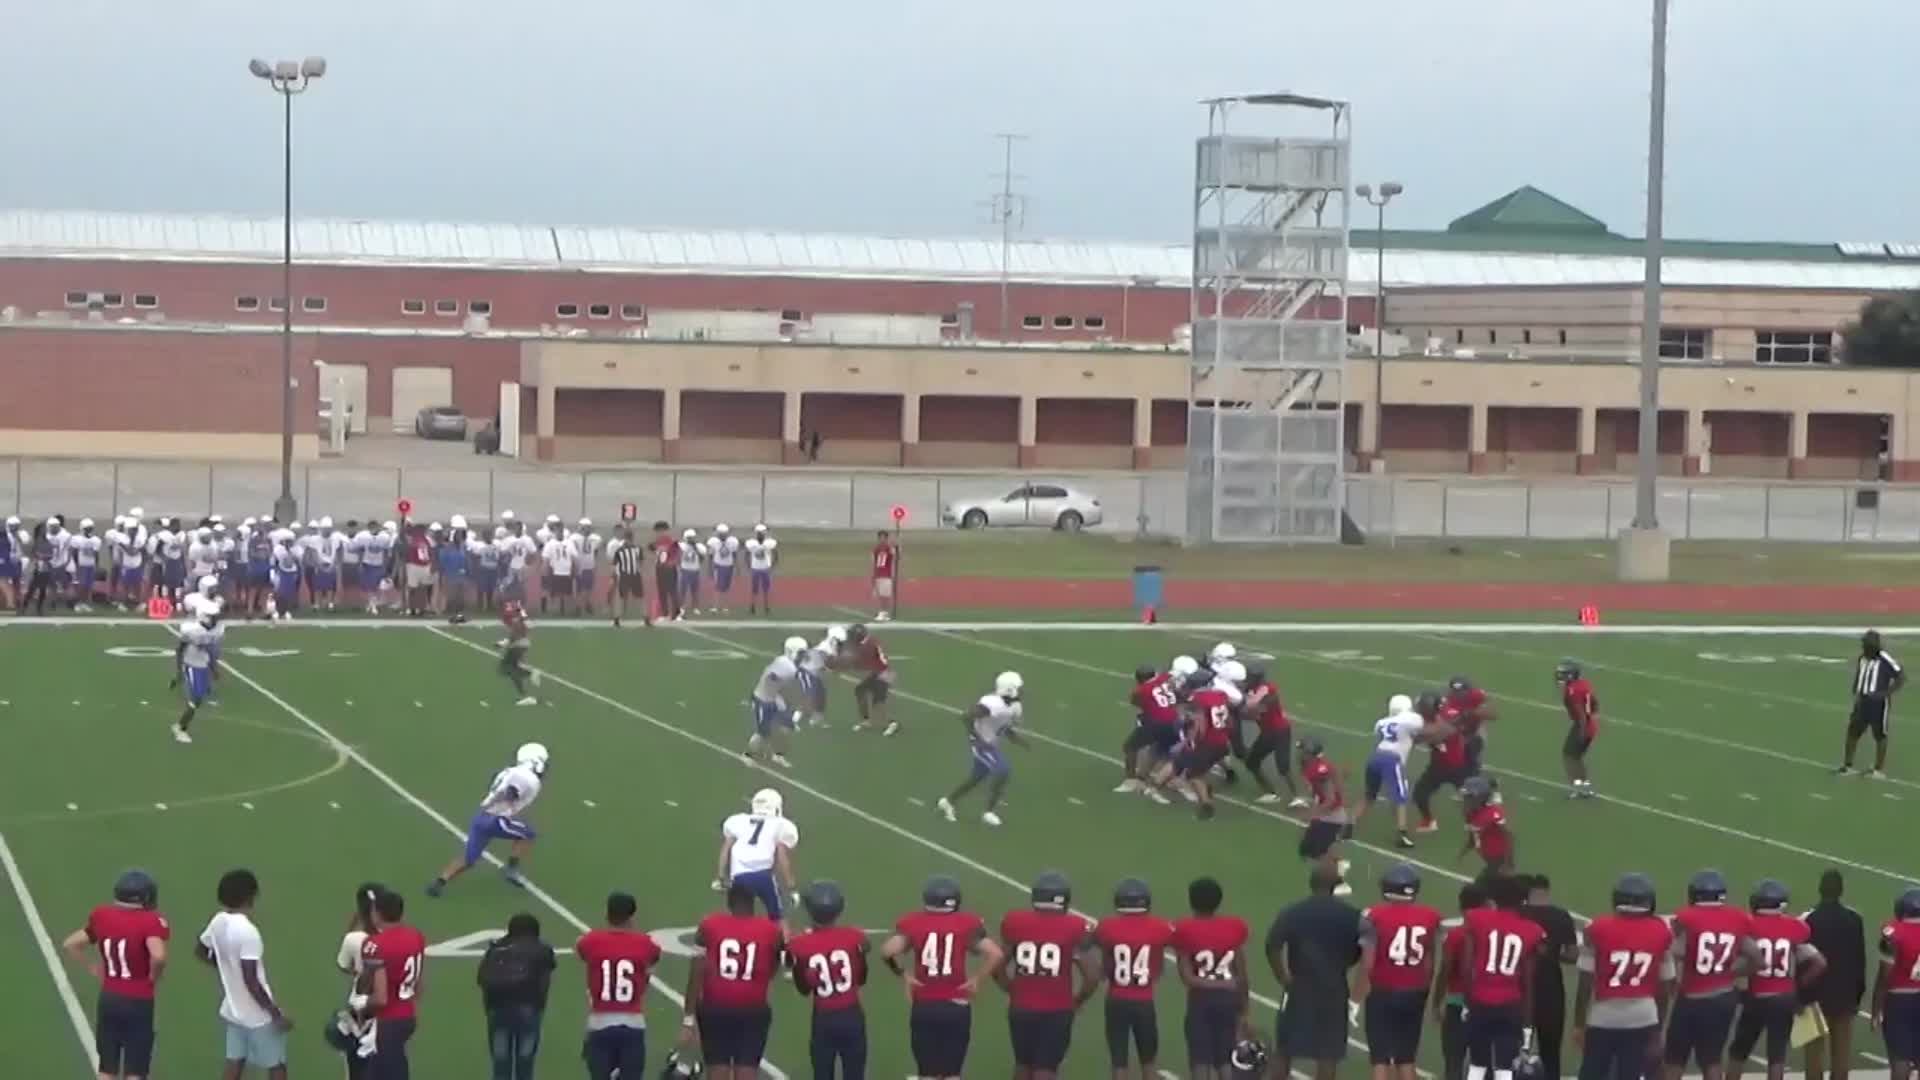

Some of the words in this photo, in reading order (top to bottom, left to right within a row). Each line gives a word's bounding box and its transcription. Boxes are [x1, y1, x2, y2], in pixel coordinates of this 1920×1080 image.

[747, 818, 765, 845] 7
[103, 937, 132, 979] 11
[719, 938, 755, 981] 61
[921, 932, 954, 977] 41
[1016, 941, 1061, 977] 99
[1113, 944, 1151, 986] 84
[1388, 925, 1427, 966] 45
[1485, 930, 1523, 976] 10
[1696, 931, 1736, 975] 67
[398, 952, 423, 1000] 21
[601, 959, 635, 1002] 16
[808, 950, 852, 998] 33
[1608, 950, 1652, 987] 77
